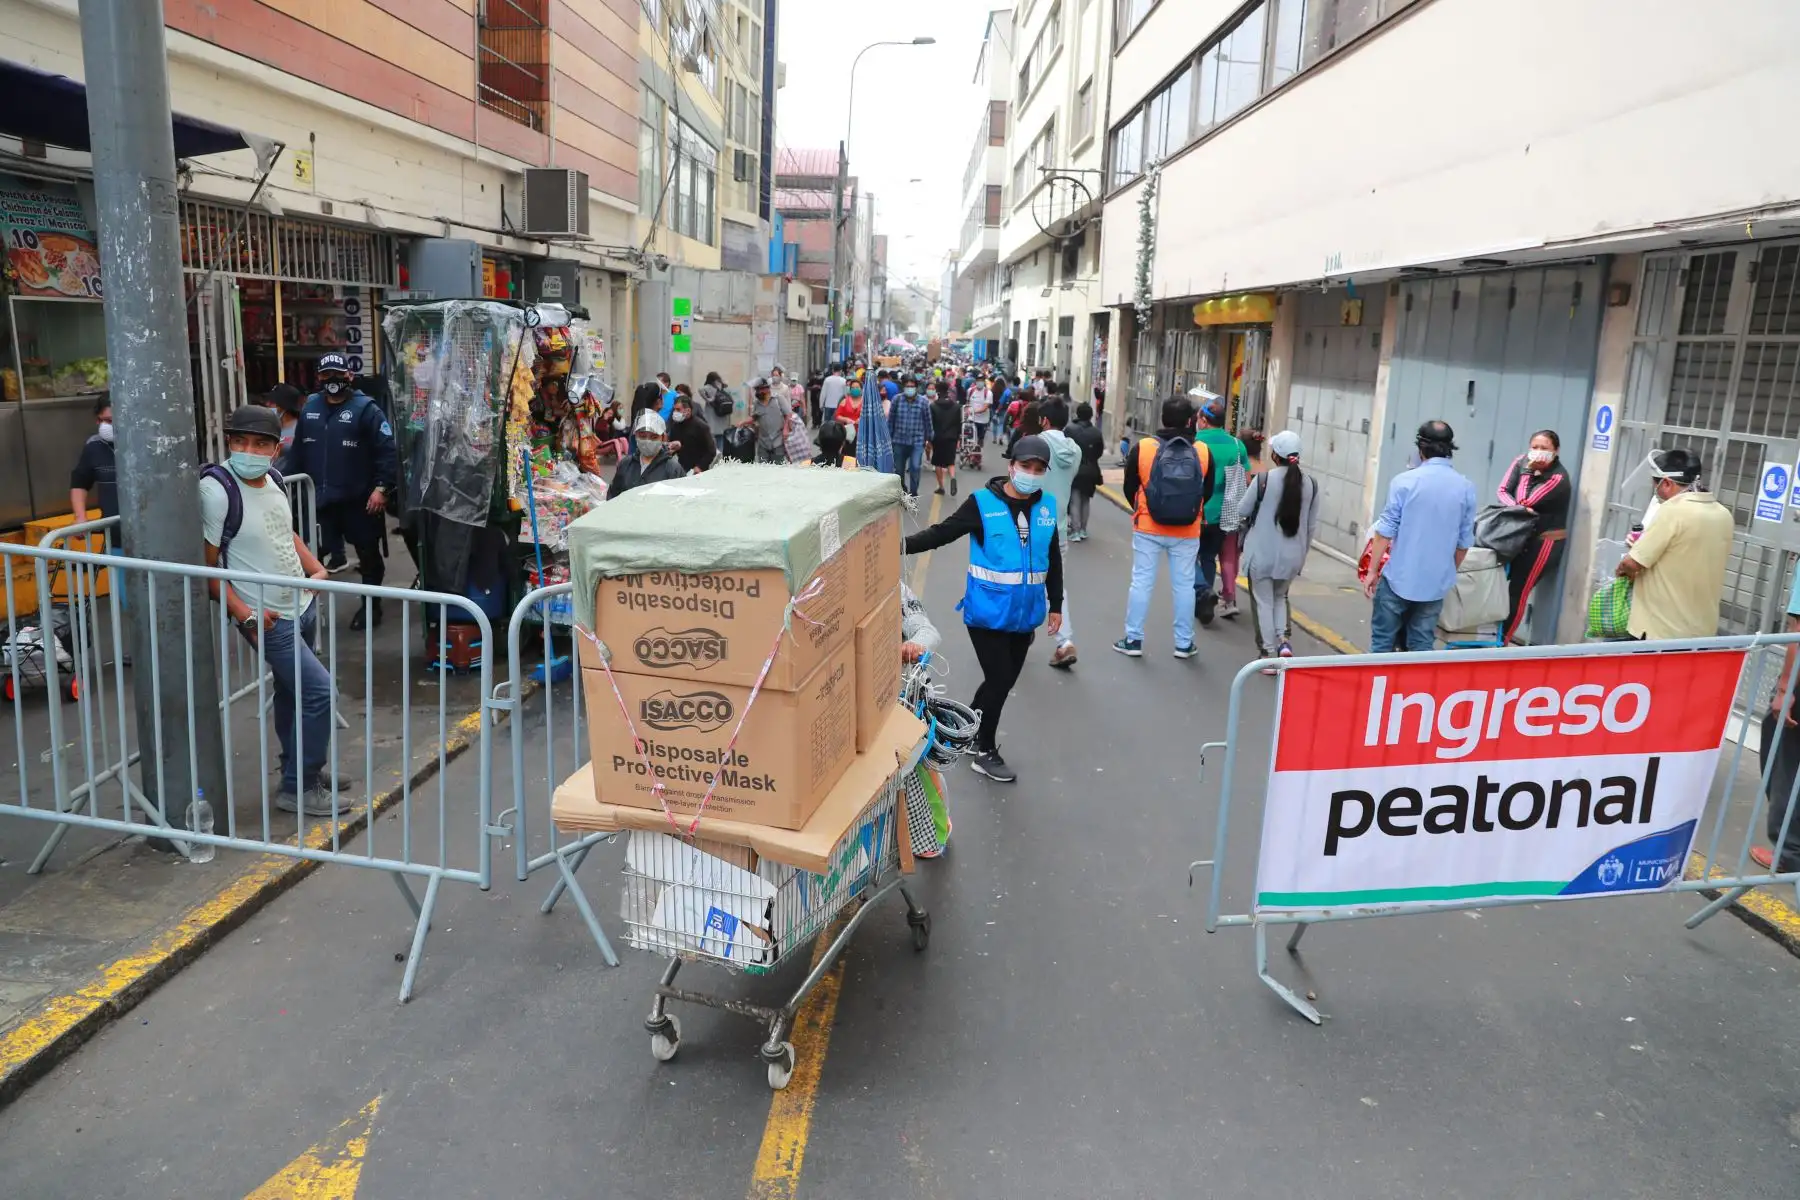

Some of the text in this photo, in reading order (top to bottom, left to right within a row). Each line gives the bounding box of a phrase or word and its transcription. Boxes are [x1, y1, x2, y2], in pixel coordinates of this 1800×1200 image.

[9, 214, 35, 226] Arroz
[48, 218, 87, 230] Mariscos
[12, 228, 38, 249] 10
[651, 571, 761, 598] Protective
[617, 590, 735, 619] Disposable
[634, 638, 728, 660] ISACCO
[640, 699, 734, 721] ISACCO
[1364, 675, 1651, 759] Ingreso
[634, 738, 750, 767] Disposable
[612, 755, 777, 792] Protective Mask
[686, 789, 708, 800] drople
[1323, 756, 1661, 857] peatonal
